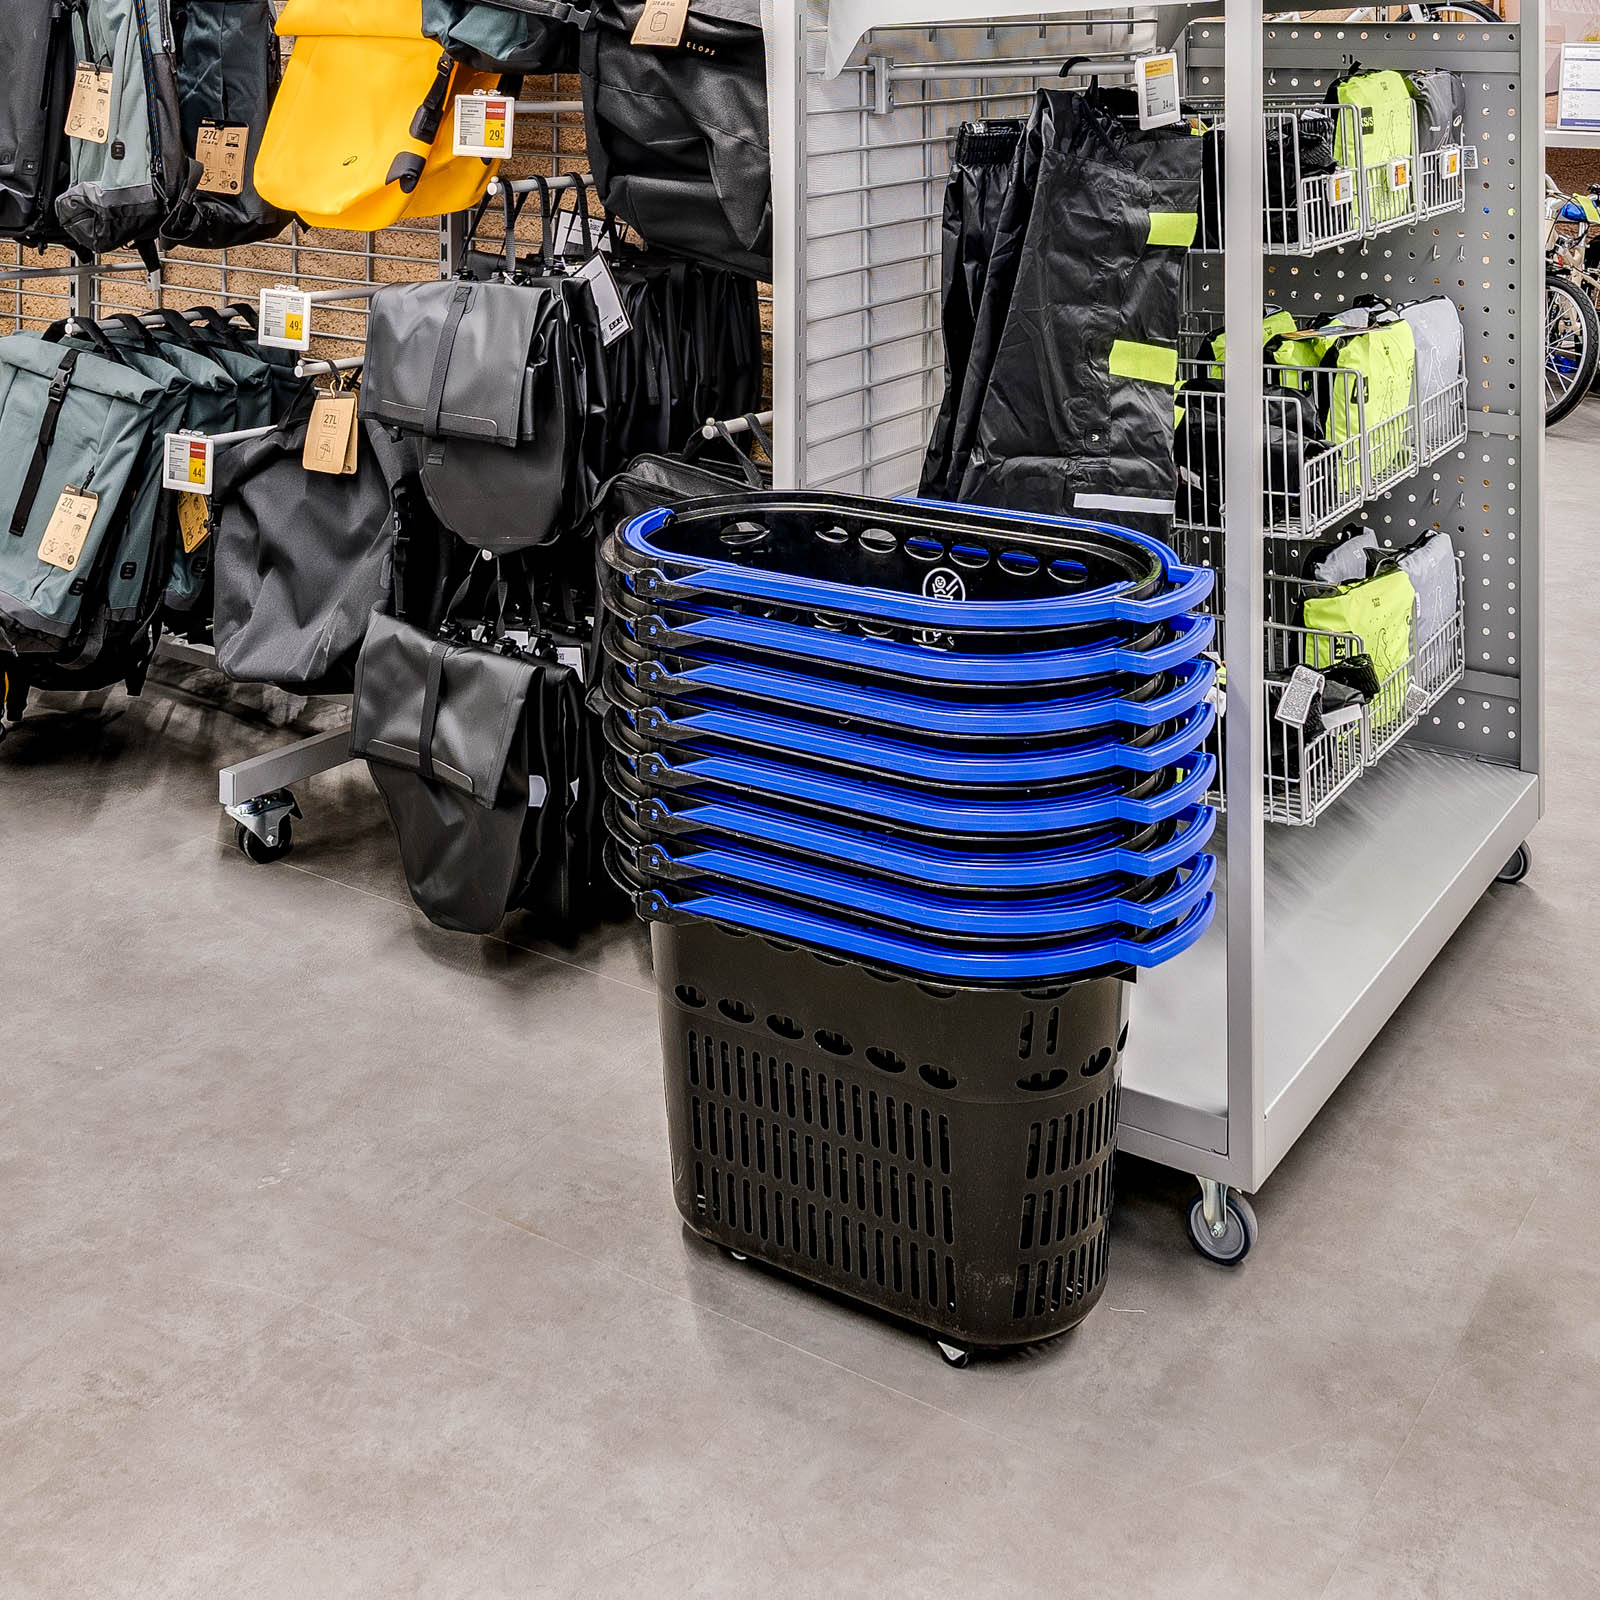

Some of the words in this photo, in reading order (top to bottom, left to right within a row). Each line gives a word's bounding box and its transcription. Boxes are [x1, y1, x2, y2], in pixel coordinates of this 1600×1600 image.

[686, 41, 717, 56] ELOPS
[79, 73, 92, 85] 27L
[202, 129, 218, 141] 27L
[323, 414, 337, 425] 27L
[61, 496, 73, 509] 27L
